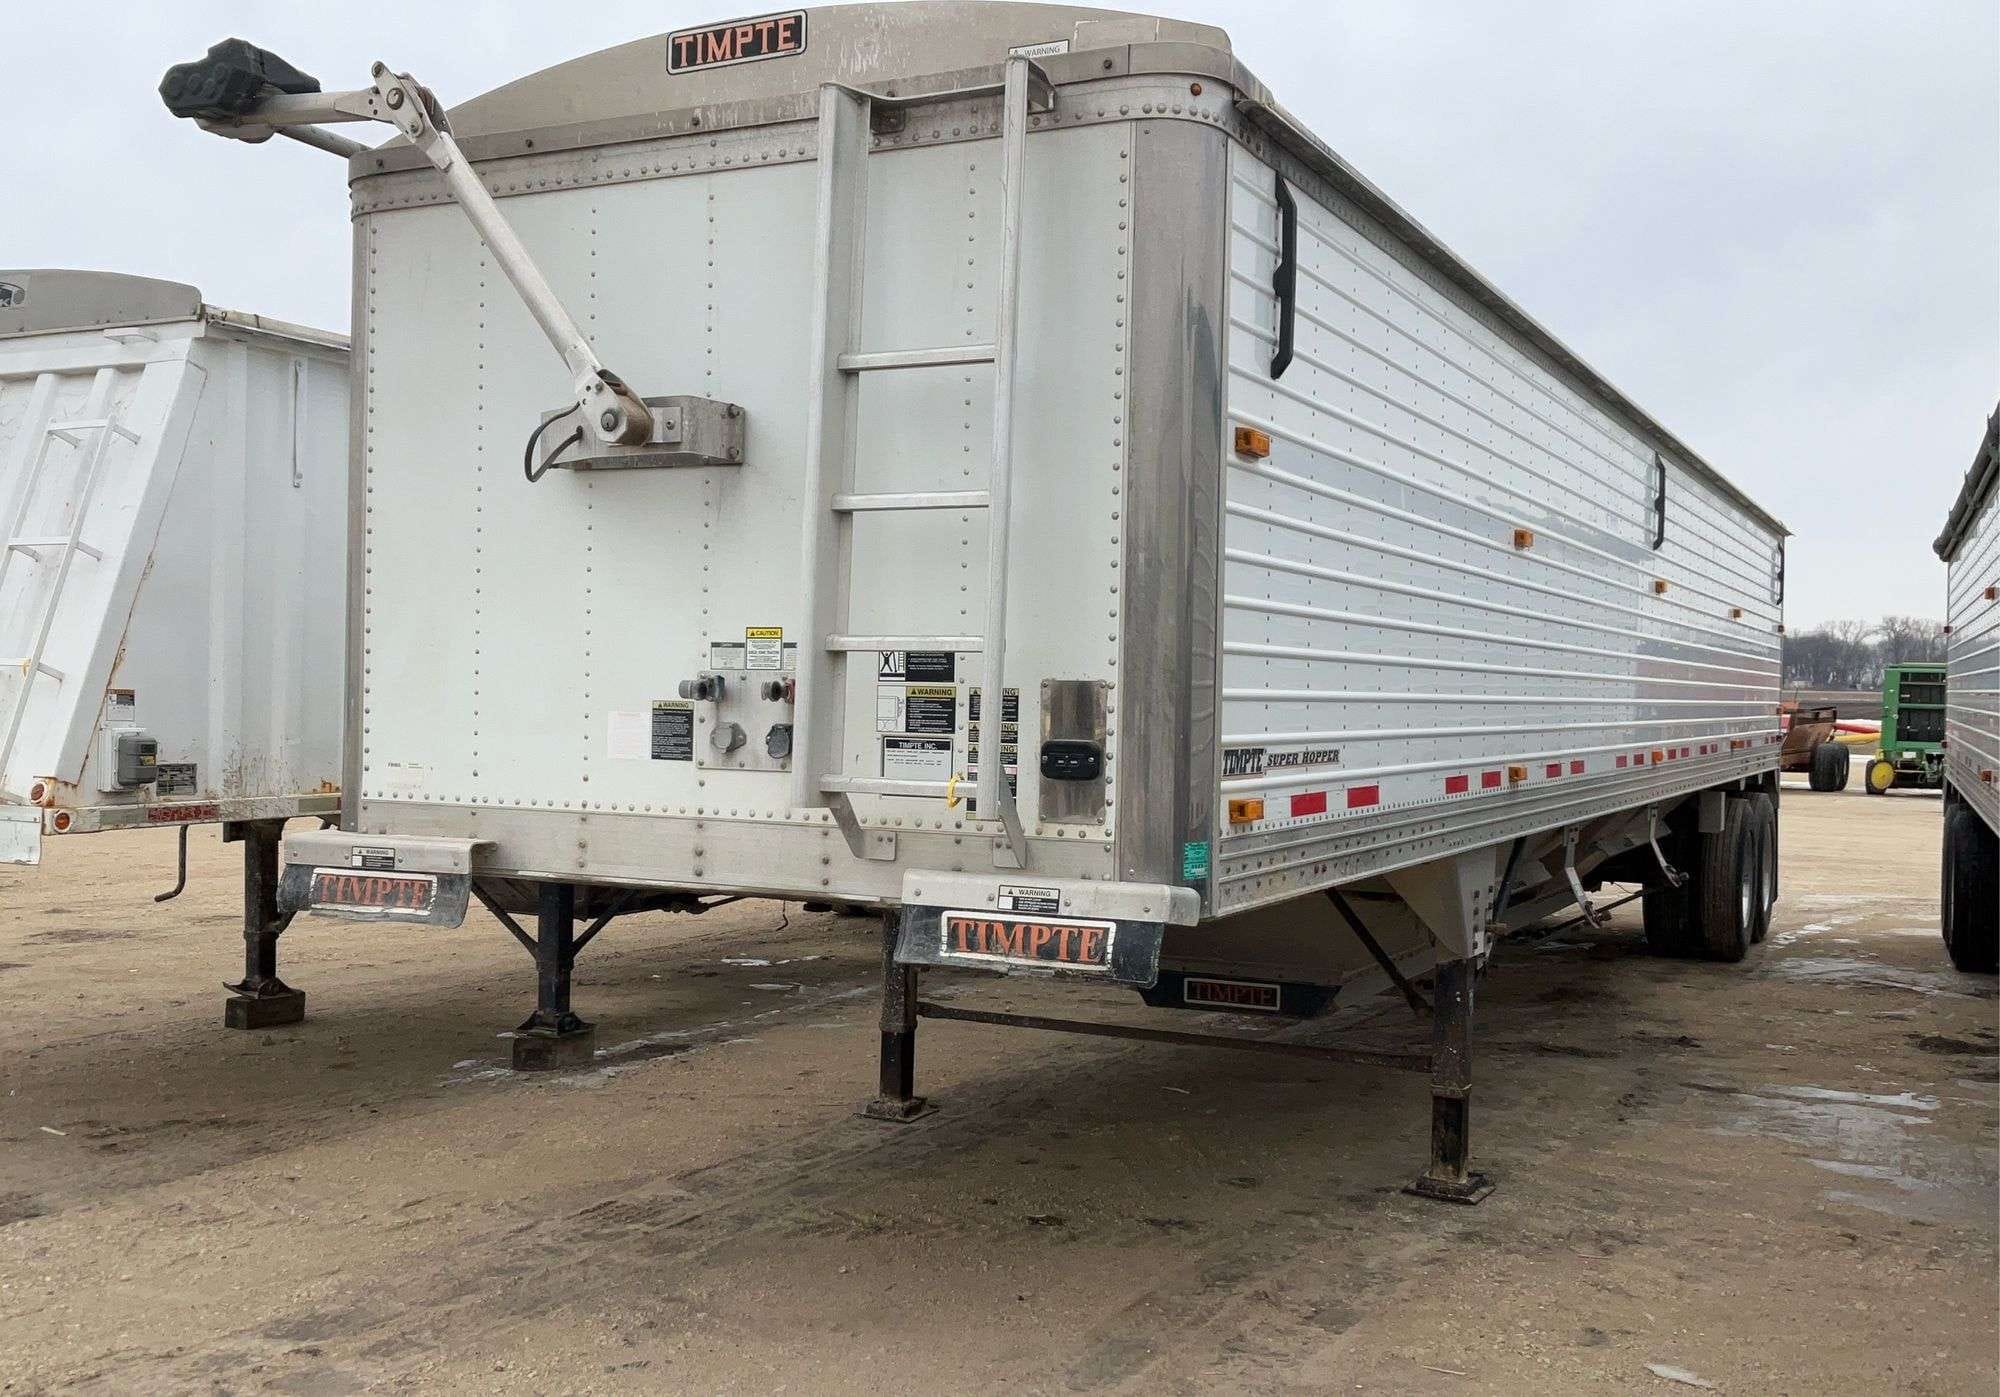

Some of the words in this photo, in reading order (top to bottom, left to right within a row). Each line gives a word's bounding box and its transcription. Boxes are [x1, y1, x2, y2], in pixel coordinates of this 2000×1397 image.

[674, 17, 796, 67] TIMPTE
[1024, 46, 1060, 56] WARNING
[1267, 752, 1299, 767] SUPER
[1302, 749, 1340, 764] HOPPER
[319, 874, 428, 909] TIMPTE
[1018, 889, 1051, 897] WARNING
[950, 918, 1104, 963] TIMPTE
[1190, 981, 1274, 1004] TIMPTE
